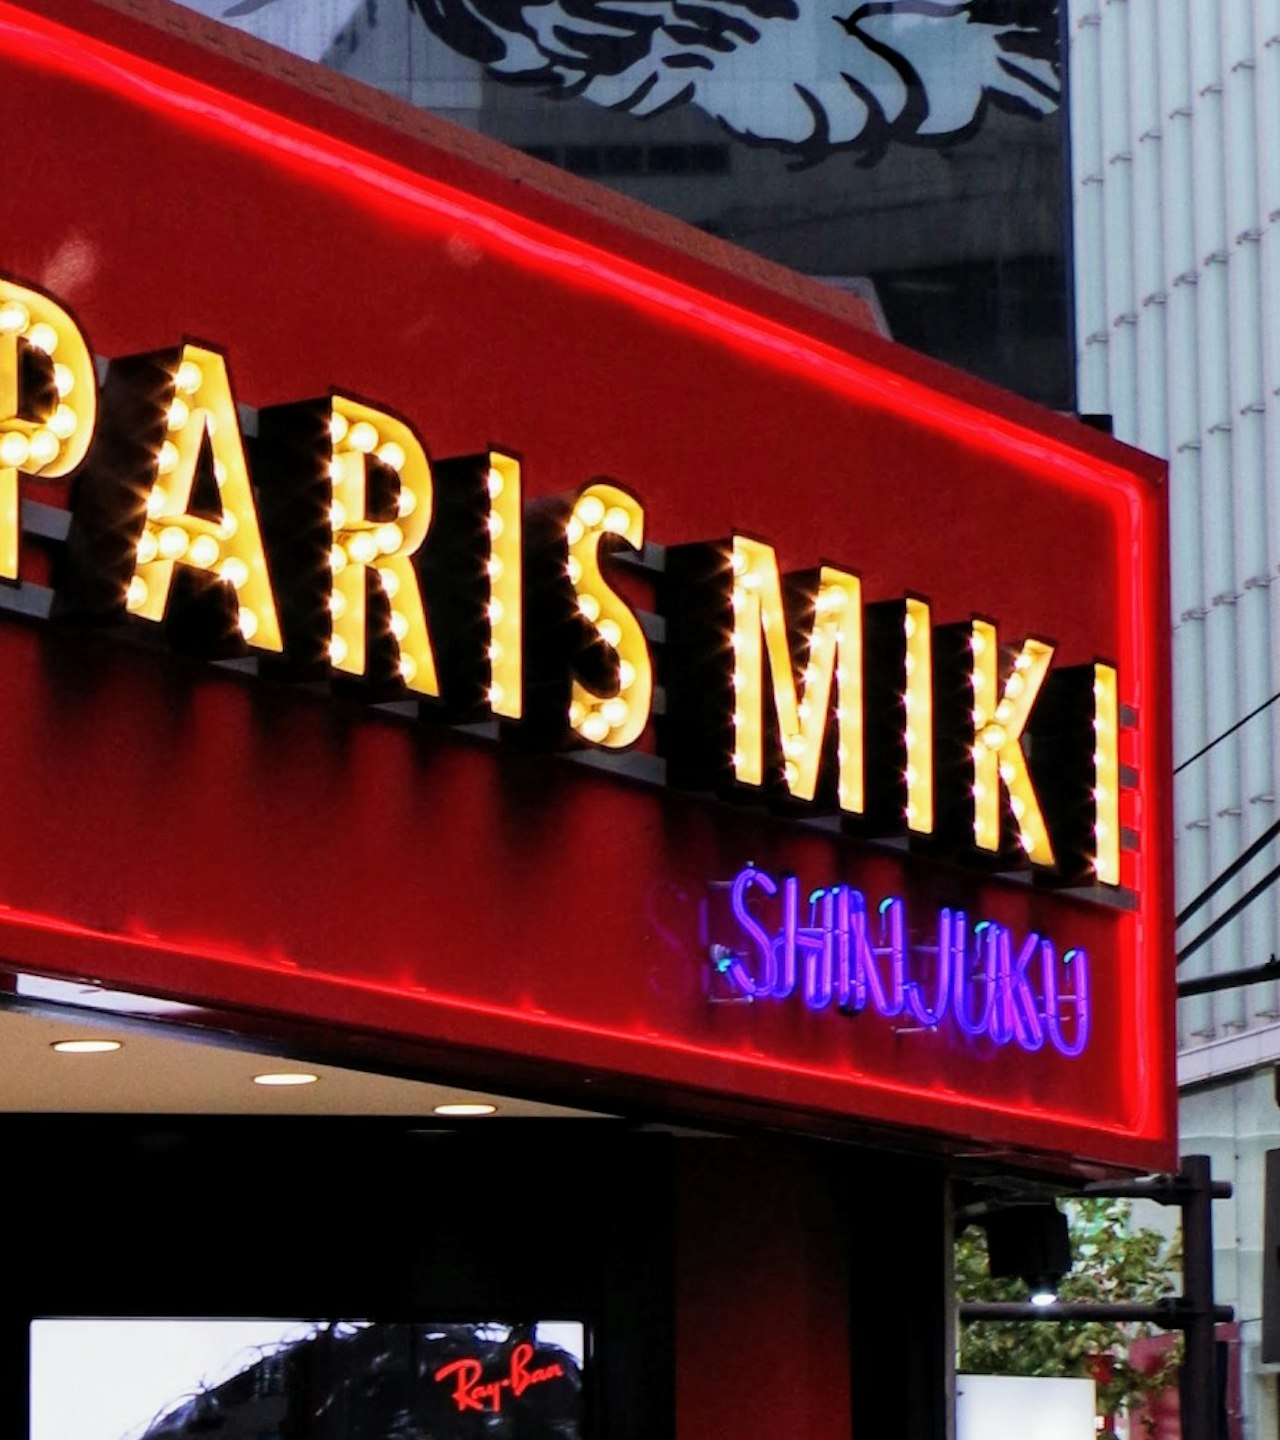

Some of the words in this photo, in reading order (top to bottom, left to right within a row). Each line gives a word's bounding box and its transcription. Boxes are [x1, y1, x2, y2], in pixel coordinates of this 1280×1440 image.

[730, 533, 1121, 886] MIKI
[725, 862, 1094, 1058] SHINJUKU
[435, 1343, 563, 1411] Ray-Ban
